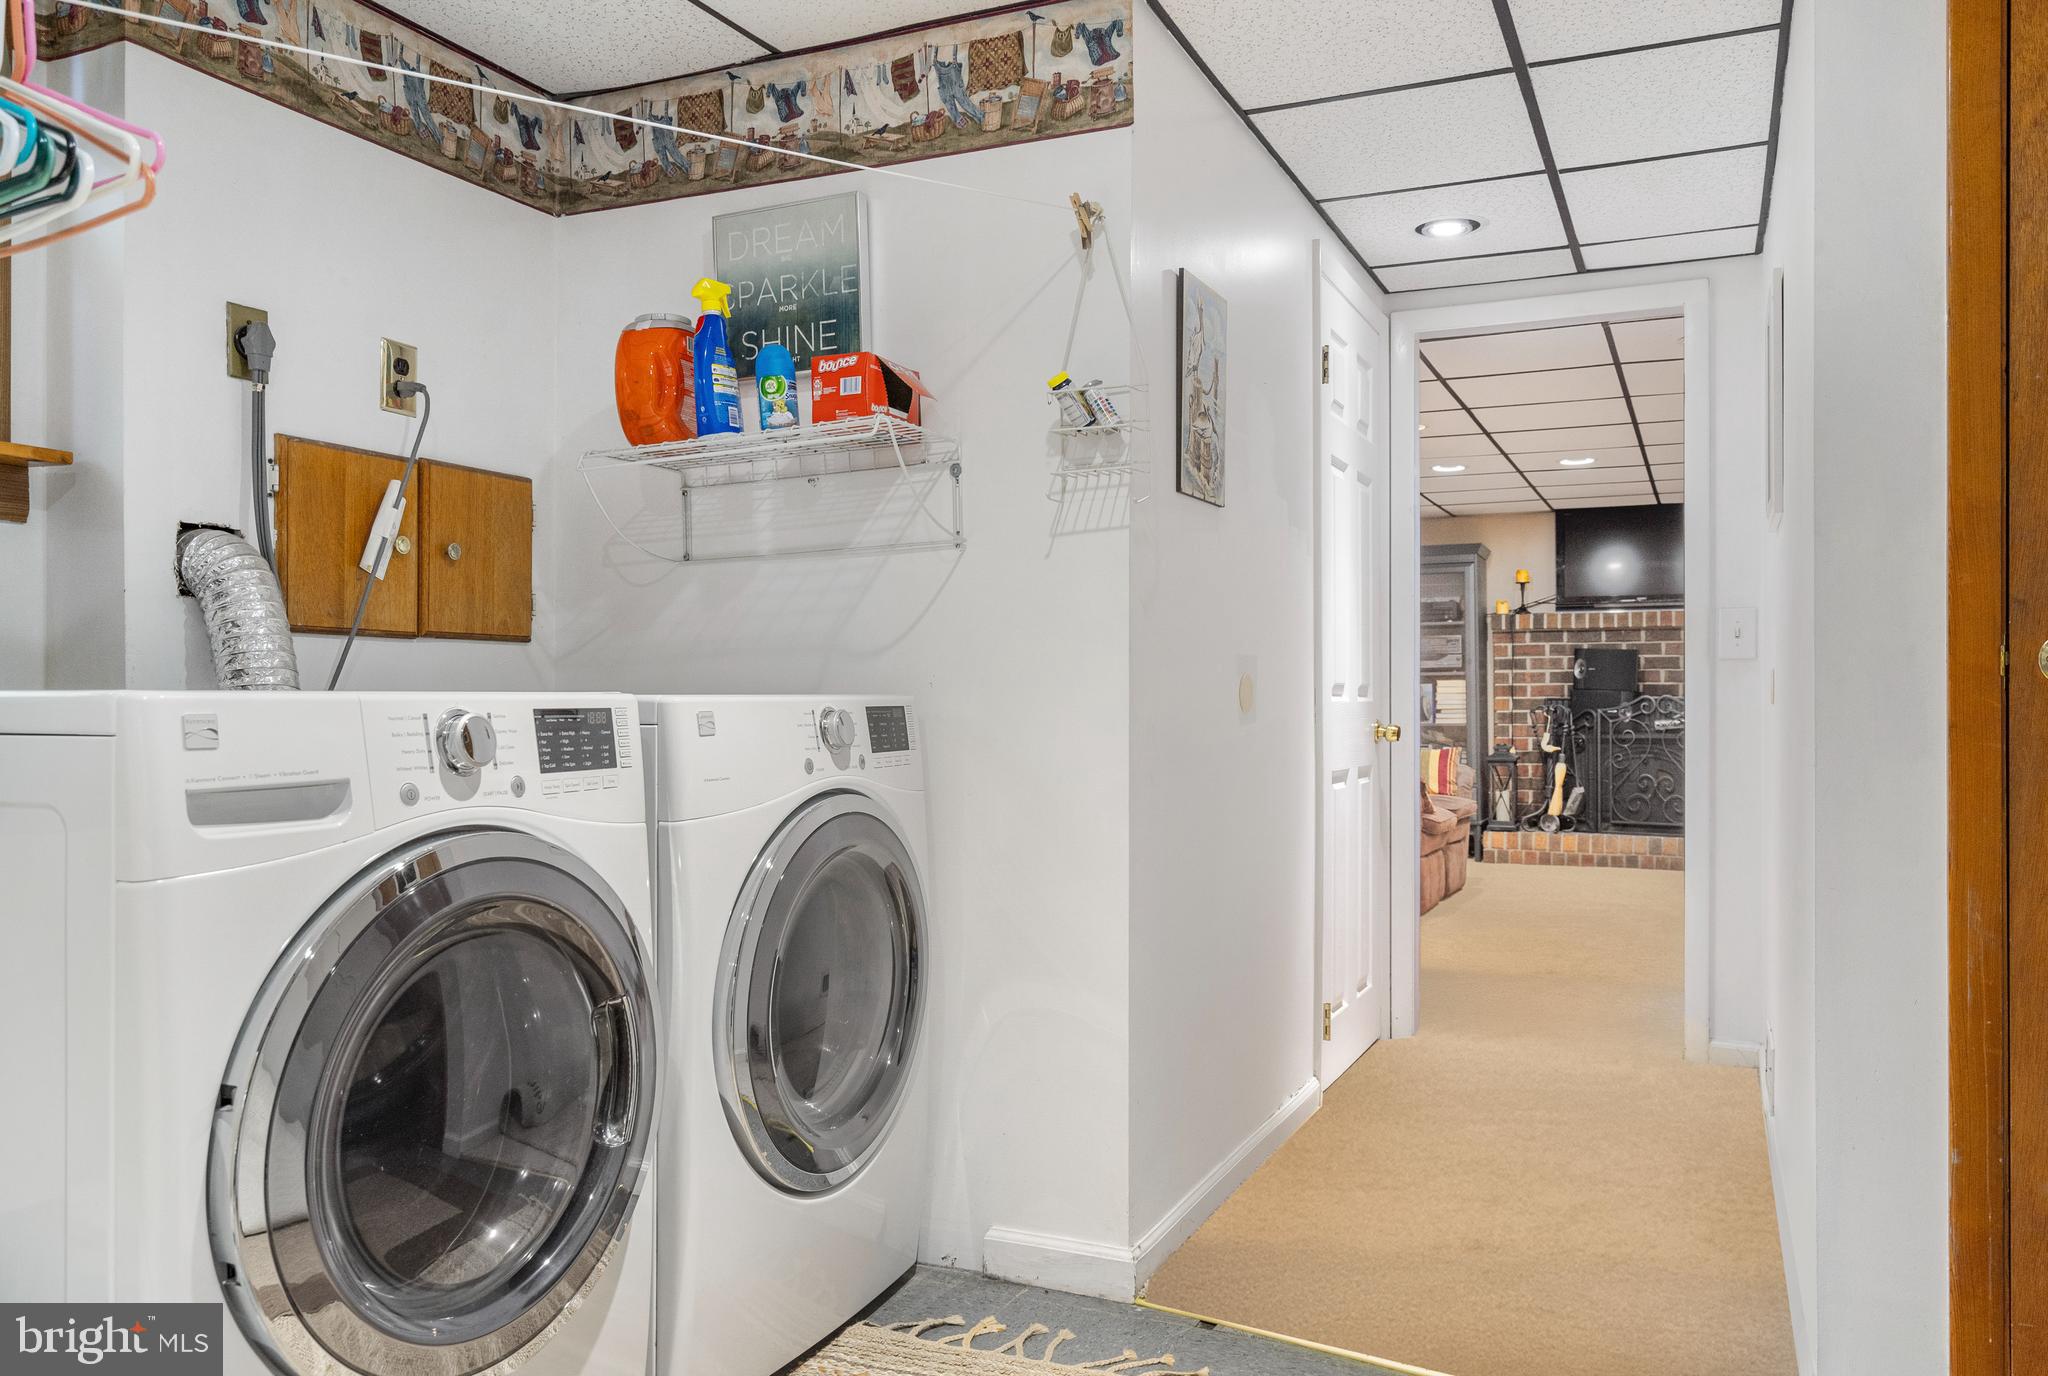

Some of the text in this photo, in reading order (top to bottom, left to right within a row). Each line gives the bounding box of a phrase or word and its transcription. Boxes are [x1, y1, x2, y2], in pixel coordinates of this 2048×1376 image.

[728, 213, 845, 262] DREAM
[779, 303, 798, 312] MORE
[742, 319, 838, 360] SHINE
[818, 355, 860, 373] bounce
